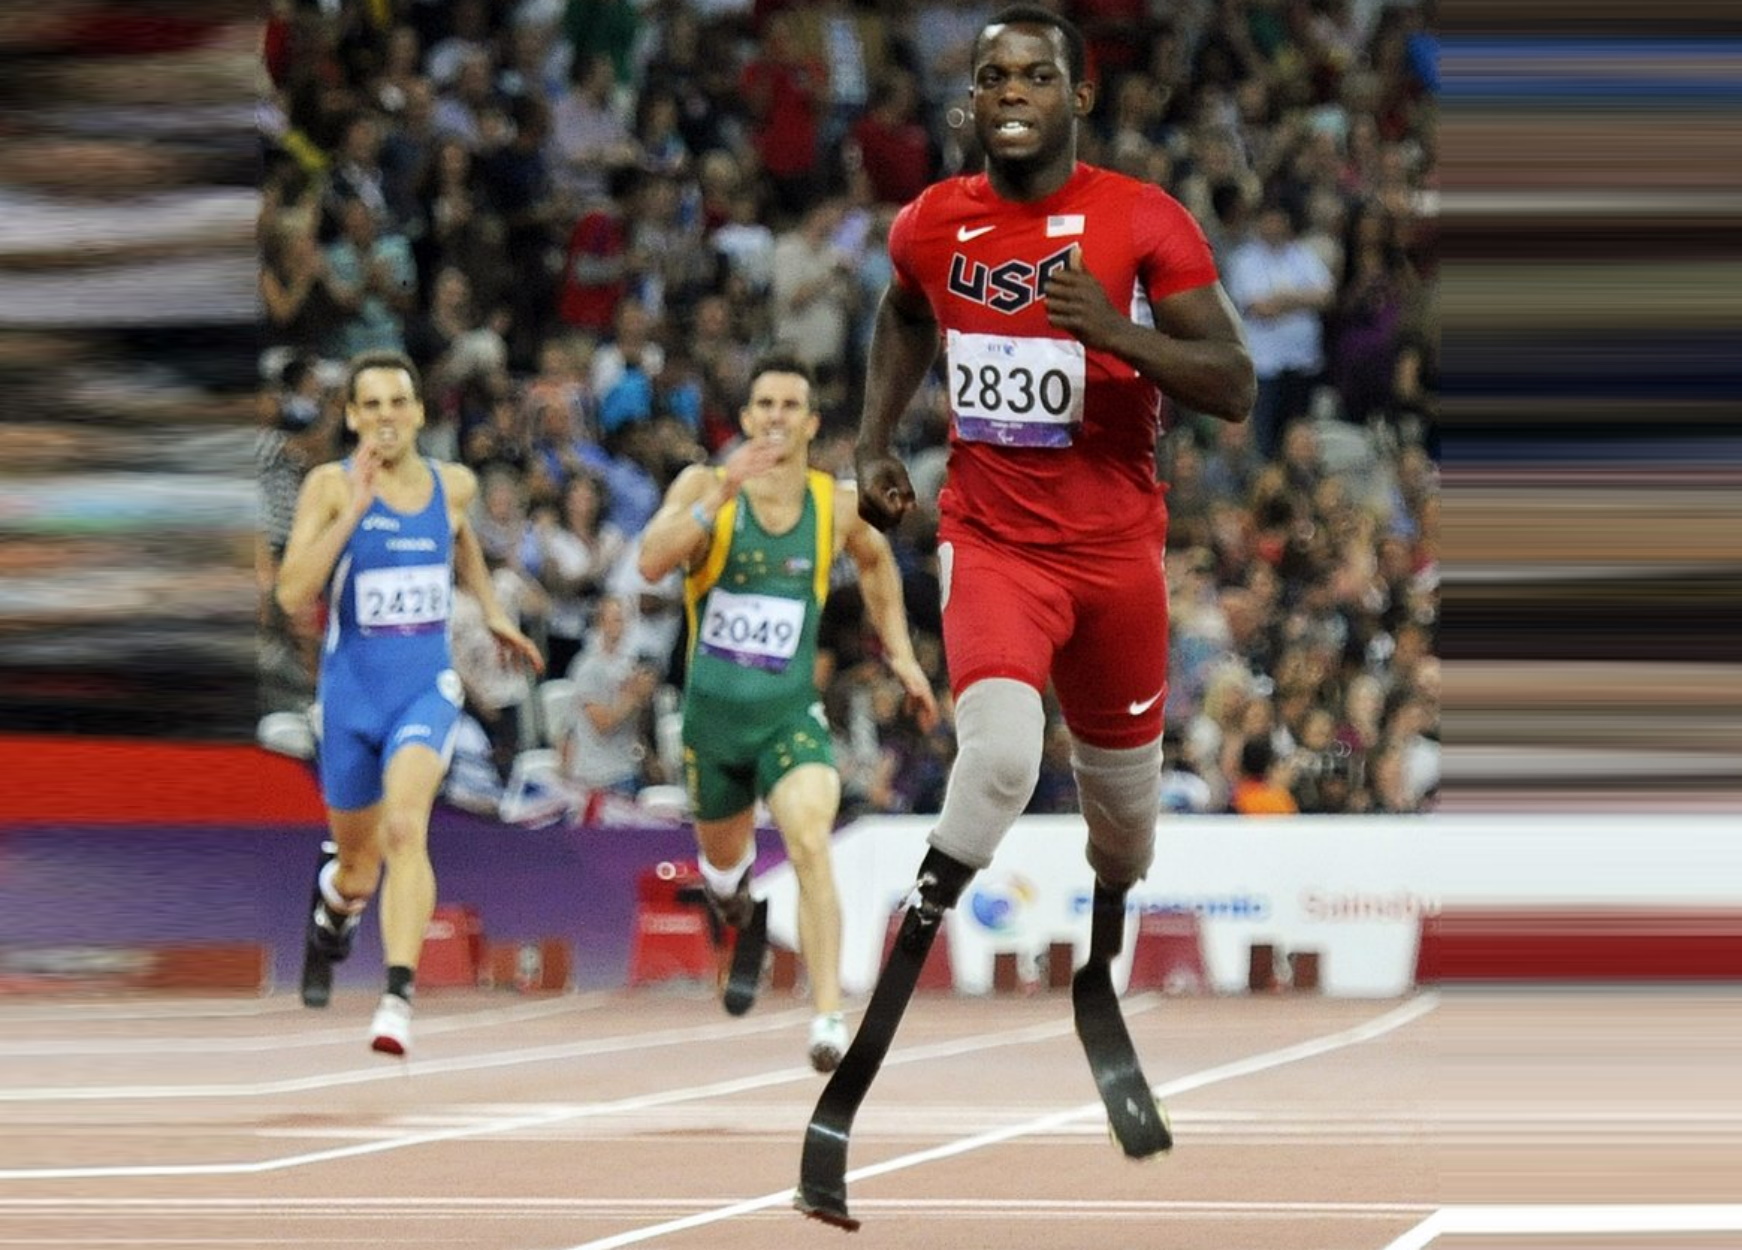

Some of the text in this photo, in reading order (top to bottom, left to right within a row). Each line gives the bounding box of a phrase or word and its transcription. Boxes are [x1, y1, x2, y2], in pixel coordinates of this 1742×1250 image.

[957, 364, 1072, 415] 2830
[711, 610, 794, 649] 2049
[1069, 892, 1268, 916] Pnasonic
